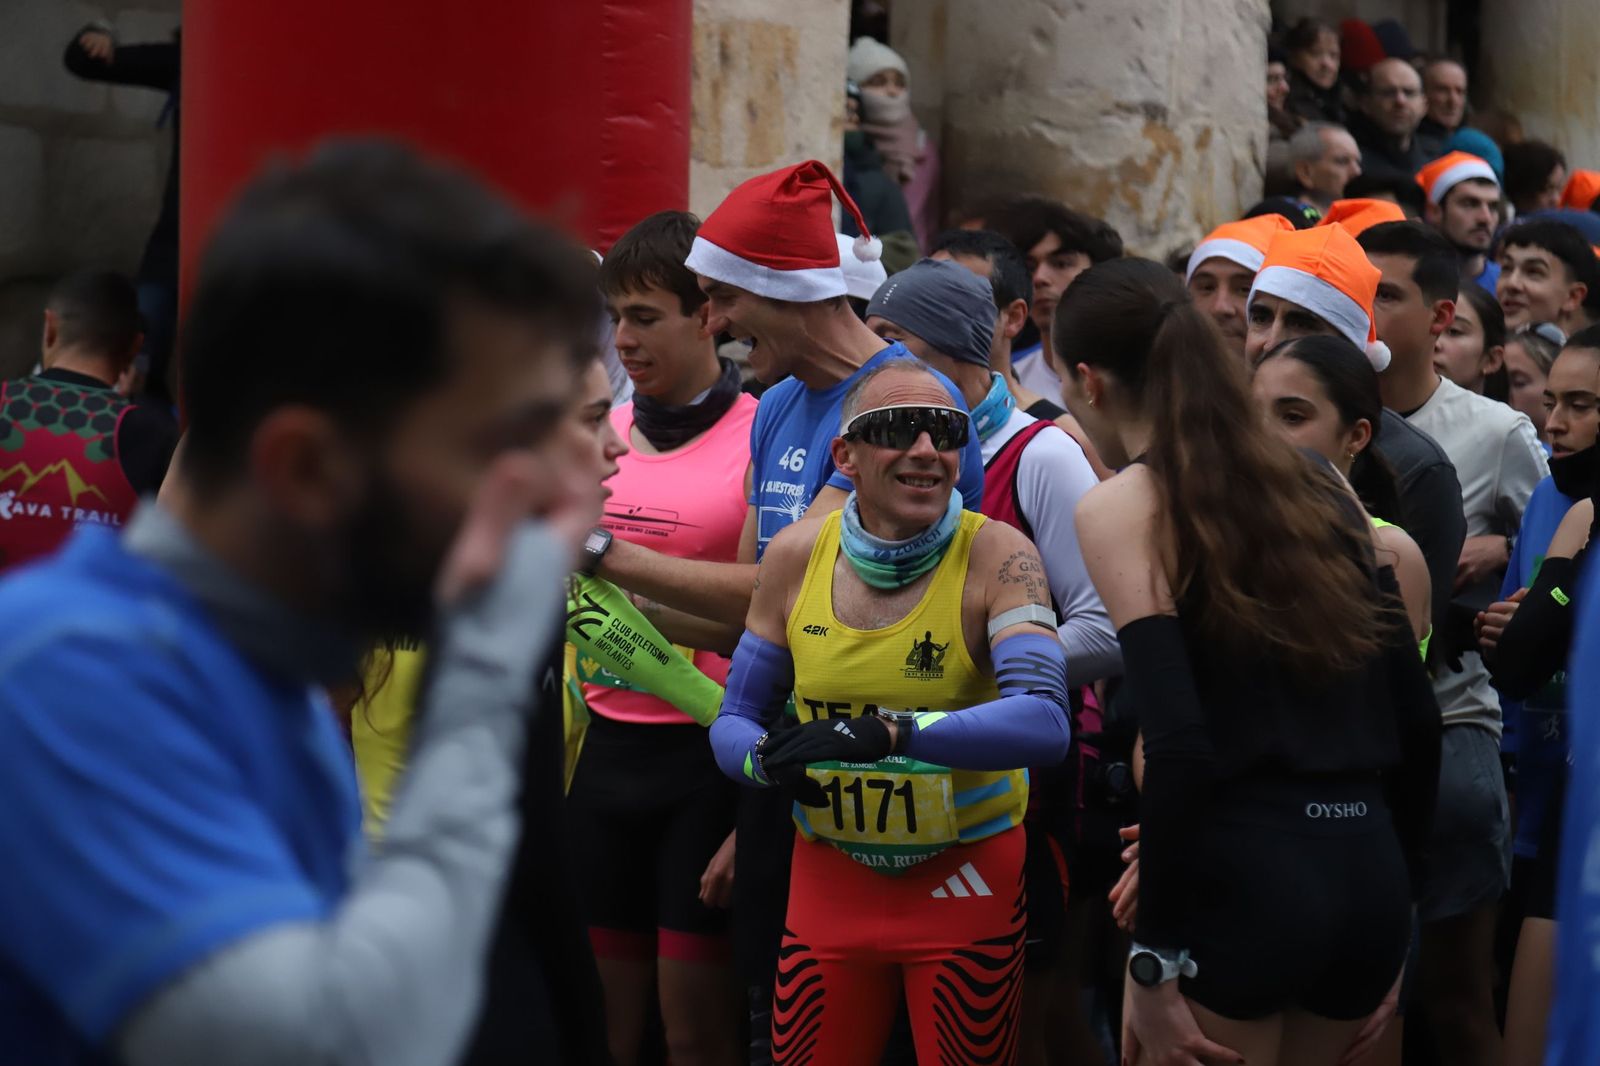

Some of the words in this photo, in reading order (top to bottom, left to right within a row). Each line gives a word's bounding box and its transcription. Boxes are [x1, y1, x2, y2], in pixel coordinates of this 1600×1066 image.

[779, 446, 807, 472] 46
[61, 505, 121, 526] TRAIL
[602, 627, 636, 657] ZAMORA
[611, 617, 633, 640] CLUB
[631, 632, 670, 666] ATLETISMO
[802, 624, 830, 637] 42K
[594, 638, 635, 671] IMPLANTES
[822, 776, 918, 834] 1171
[1306, 801, 1368, 818] OYSHO
[851, 852, 890, 868] CAJA
